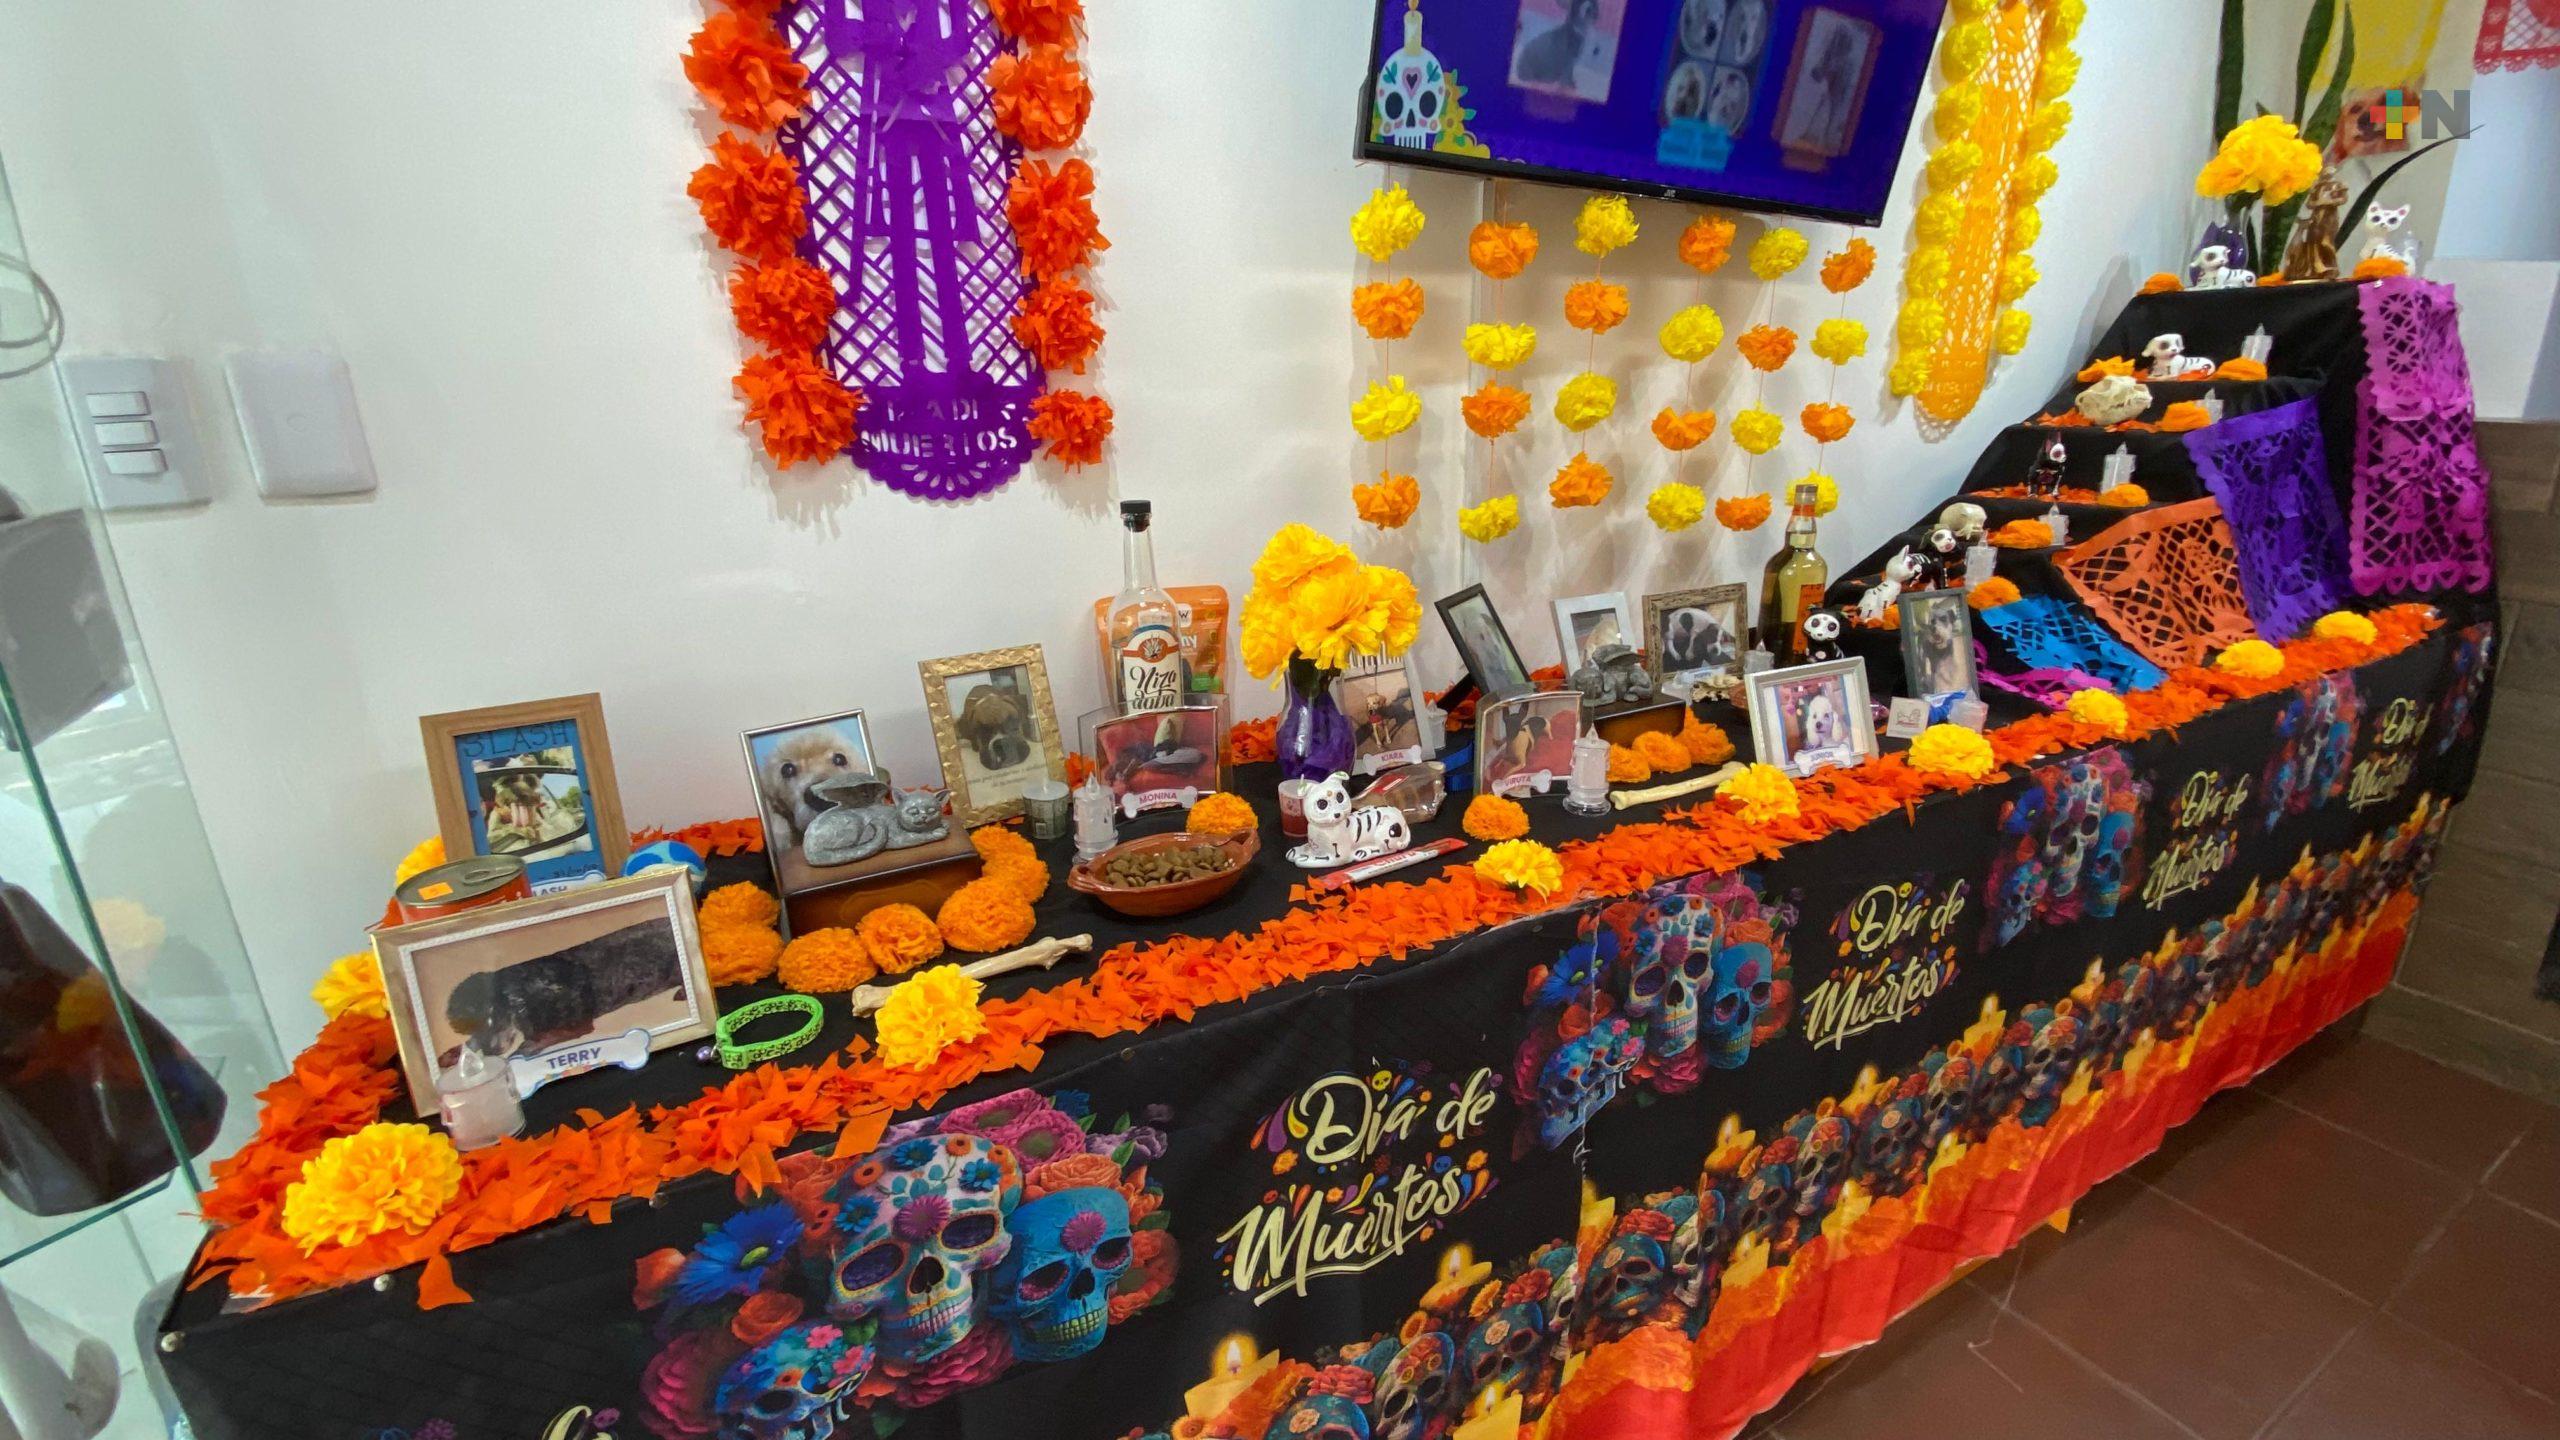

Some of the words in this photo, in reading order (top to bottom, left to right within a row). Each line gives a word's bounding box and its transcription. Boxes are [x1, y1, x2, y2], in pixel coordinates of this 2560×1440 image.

[463, 723, 570, 758] SLASH
[1139, 791, 1178, 804] MONINA
[1930, 878, 1965, 937] de
[1803, 956, 1941, 1052] Muertos
[546, 1046, 602, 1070] TERRY
[1435, 1066, 1496, 1140] de
[1215, 1163, 1462, 1308] Muertos
